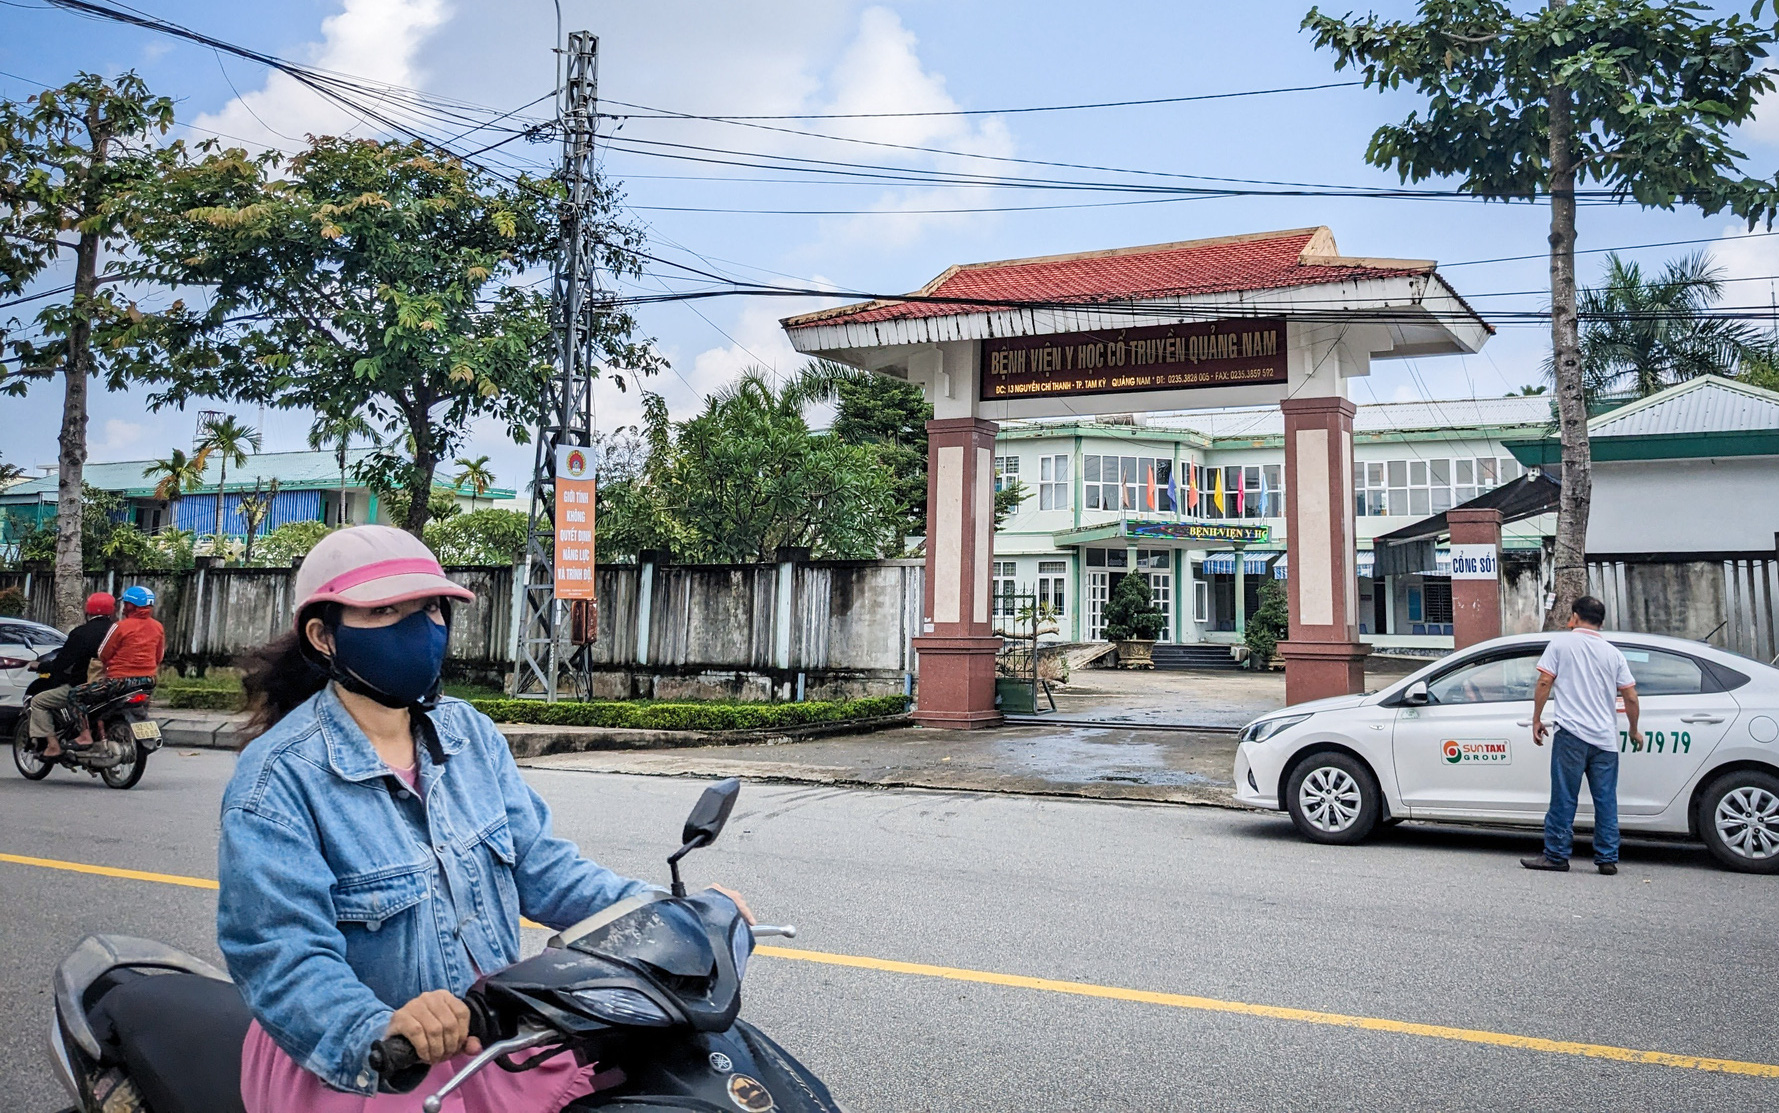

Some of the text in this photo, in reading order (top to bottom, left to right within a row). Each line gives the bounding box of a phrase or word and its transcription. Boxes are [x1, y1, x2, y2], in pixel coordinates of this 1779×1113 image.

[991, 324, 1276, 380] BỆNH VIỆN Y HỌC CỔ TRUYỀN QUẢNG NAM
[1052, 381, 1072, 391] THANH
[1085, 379, 1097, 389] TAM
[1111, 375, 1135, 387] QUẢNG
[1136, 376, 1150, 386] NAM
[1262, 368, 1274, 378] 592
[566, 508, 586, 523] KHÔNG
[1453, 550, 1477, 573] CỔNG
[1645, 731, 1665, 753] 79
[1670, 731, 1691, 754] 79
